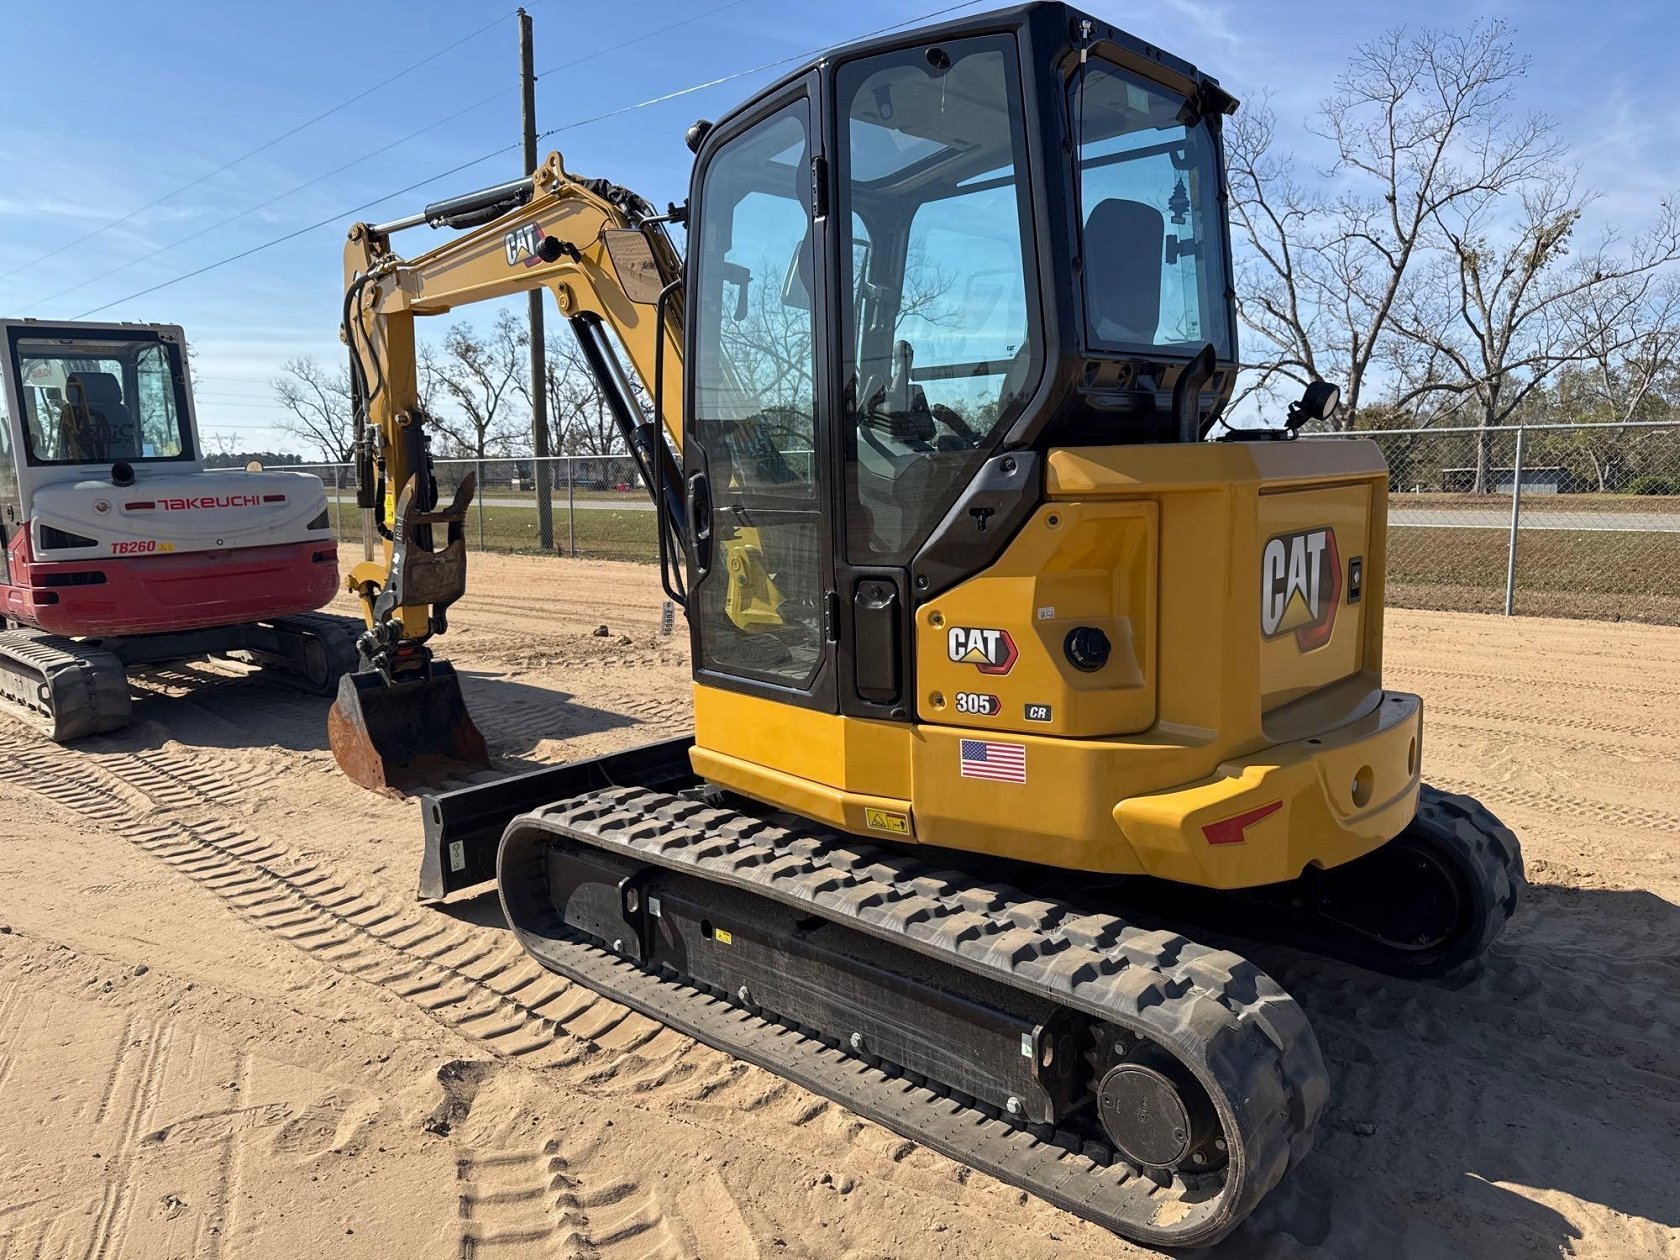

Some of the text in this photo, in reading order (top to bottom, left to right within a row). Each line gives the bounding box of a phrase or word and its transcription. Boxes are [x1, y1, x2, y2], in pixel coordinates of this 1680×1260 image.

[505, 224, 536, 265] CAT
[111, 540, 156, 554] TB260
[1262, 531, 1326, 635] CAT
[949, 627, 1000, 664] CAT
[956, 692, 990, 715] 305
[1029, 706, 1047, 719] CR
